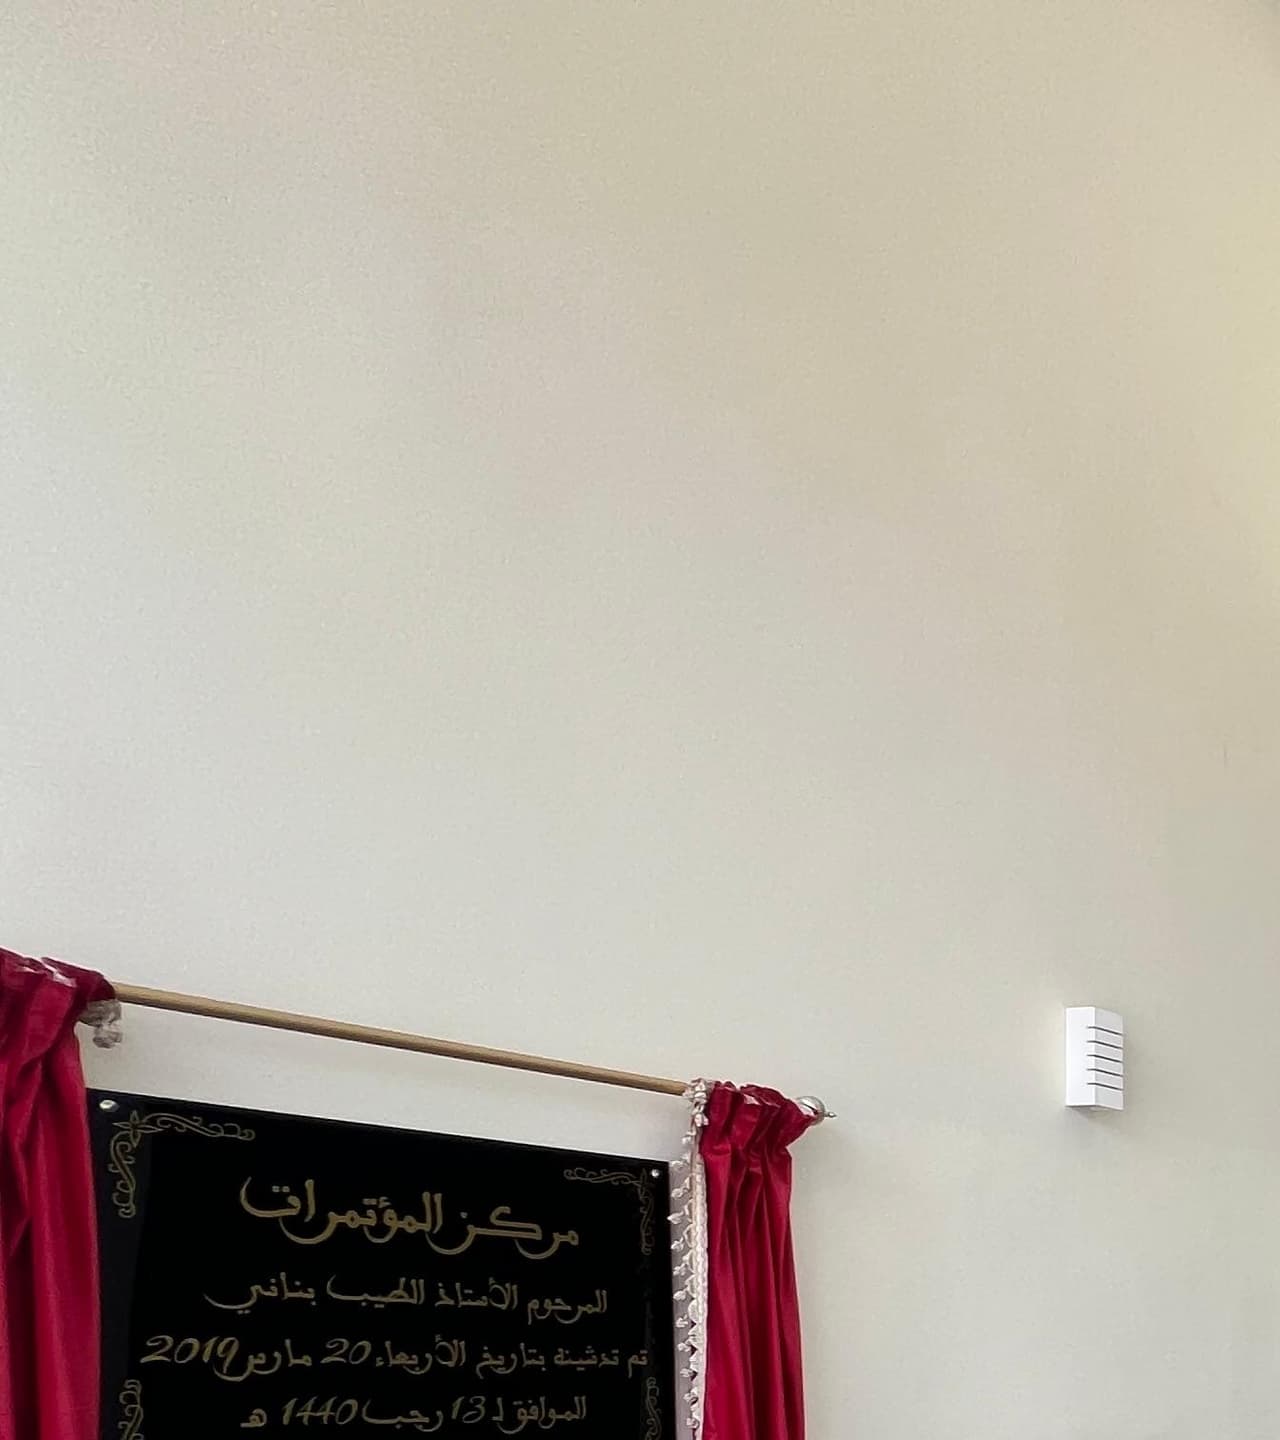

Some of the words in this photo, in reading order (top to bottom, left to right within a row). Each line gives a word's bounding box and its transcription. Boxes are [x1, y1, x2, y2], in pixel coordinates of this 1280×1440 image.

[240, 1177, 443, 1245] المؤتمرات
[426, 1206, 580, 1260] مركز
[203, 1271, 315, 1315] بناني
[326, 1274, 425, 1309] الطيب
[434, 1277, 519, 1311] الأستاذ
[527, 1289, 608, 1325] المرحوم
[140, 1334, 240, 1374] 2019
[213, 1338, 313, 1382] مارس
[320, 1337, 372, 1365] 20
[375, 1334, 467, 1375] الأربعاء
[475, 1342, 547, 1380] بتاريخ
[553, 1345, 620, 1371] تدشينه
[627, 1350, 648, 1379] تم
[281, 1396, 359, 1425] 1440
[362, 1399, 444, 1433] رجب
[451, 1396, 486, 1424] 13
[498, 1396, 587, 1435] الموافق
